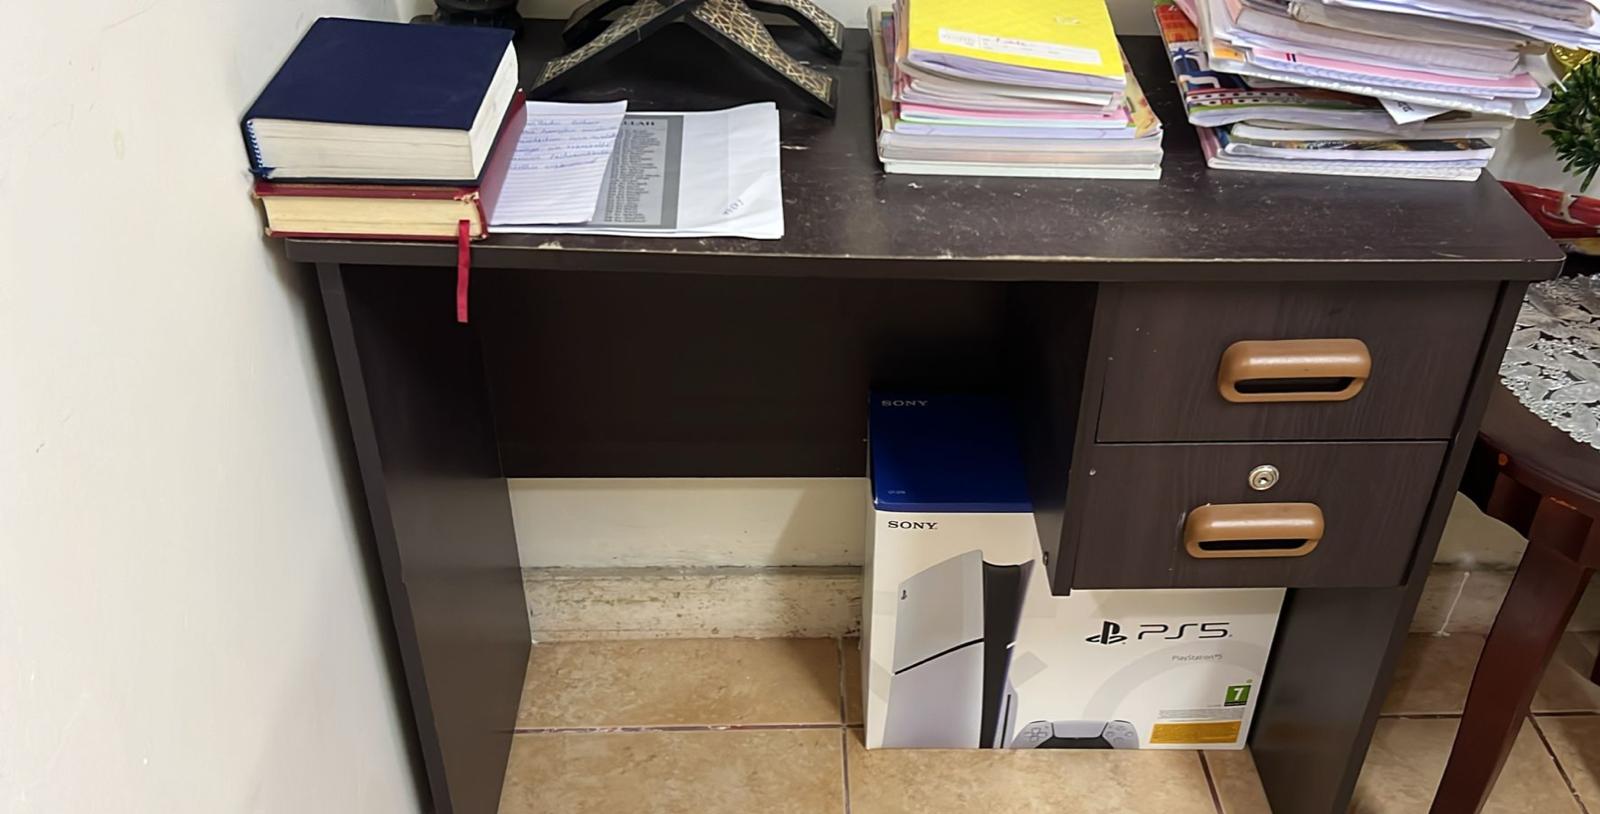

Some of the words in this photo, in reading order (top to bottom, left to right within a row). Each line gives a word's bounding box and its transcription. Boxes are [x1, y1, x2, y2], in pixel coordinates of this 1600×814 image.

[888, 520, 938, 529] SONY
[1138, 622, 1231, 639] PS5
[1233, 687, 1244, 701] 7
